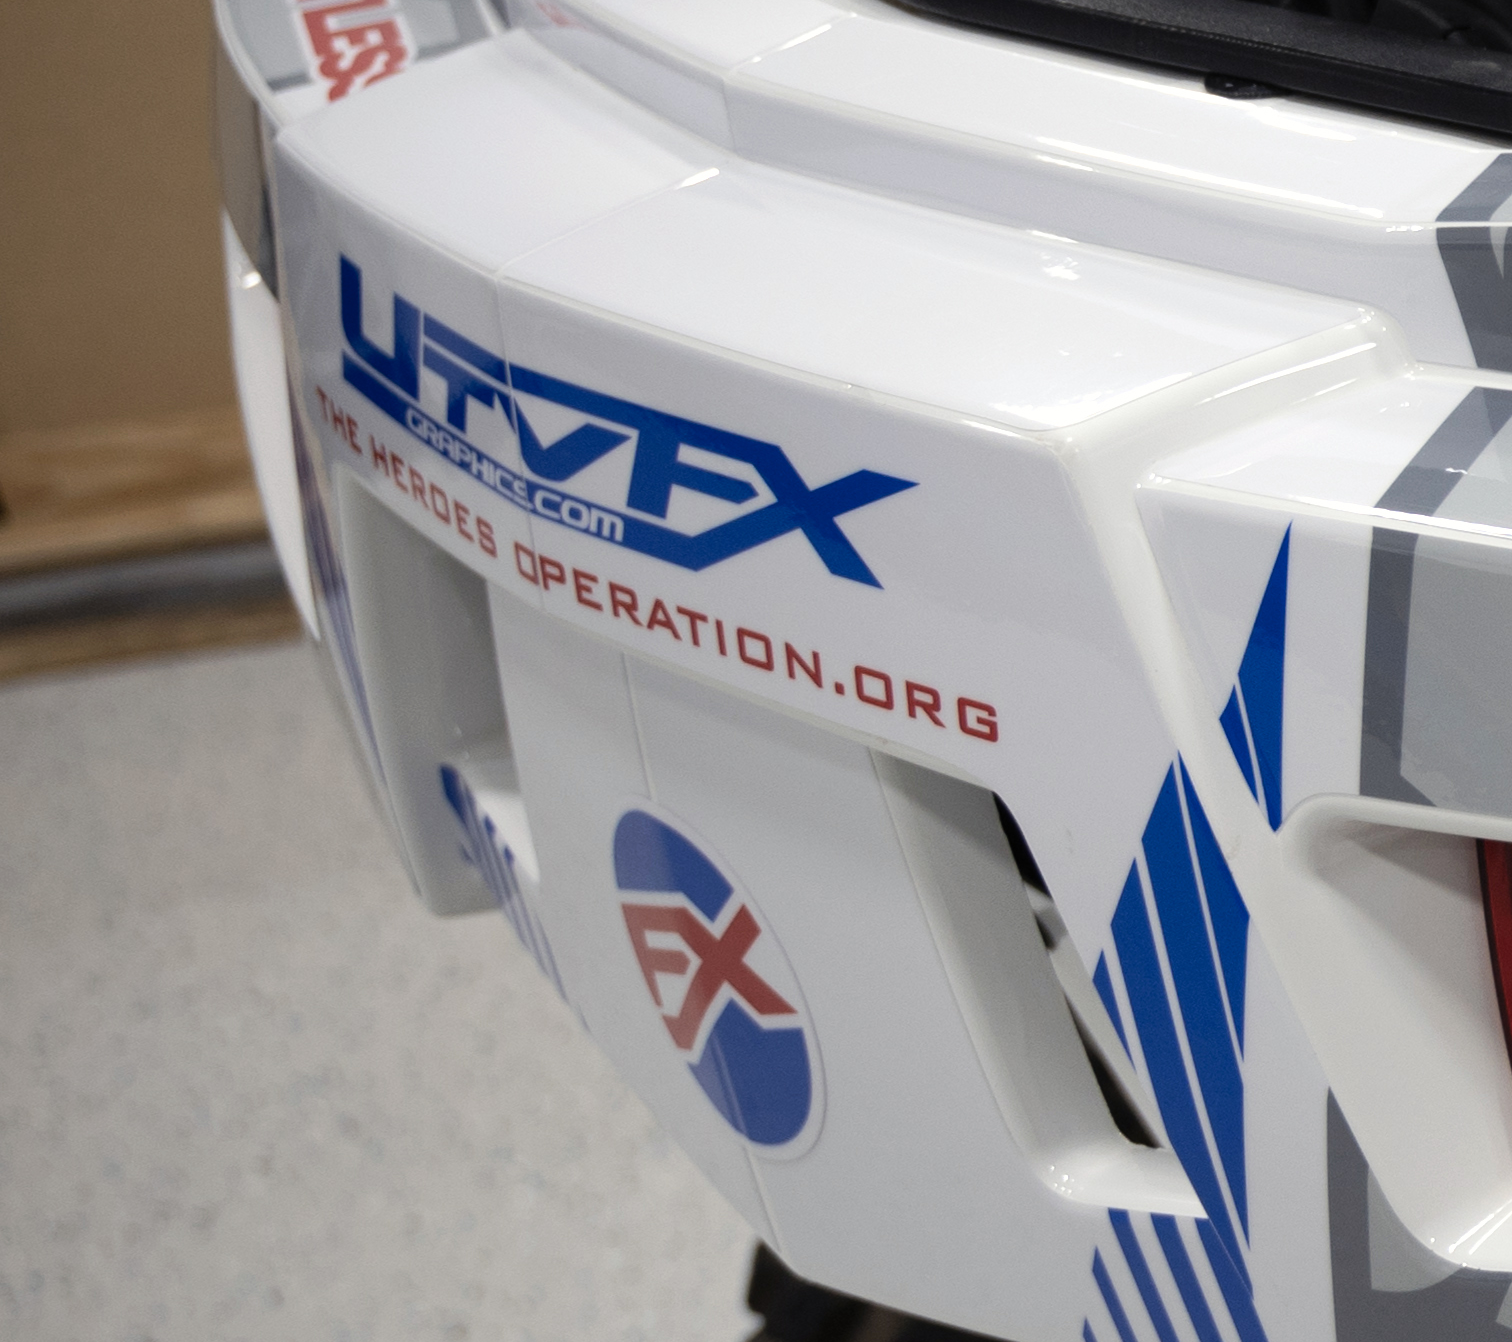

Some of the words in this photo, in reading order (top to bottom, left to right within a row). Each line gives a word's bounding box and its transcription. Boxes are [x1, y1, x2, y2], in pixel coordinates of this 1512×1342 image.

[316, 384, 363, 456] THE
[370, 433, 498, 559] HEROES
[514, 539, 998, 745] OPERATION.ORG
[340, 253, 919, 590] UTVFX
